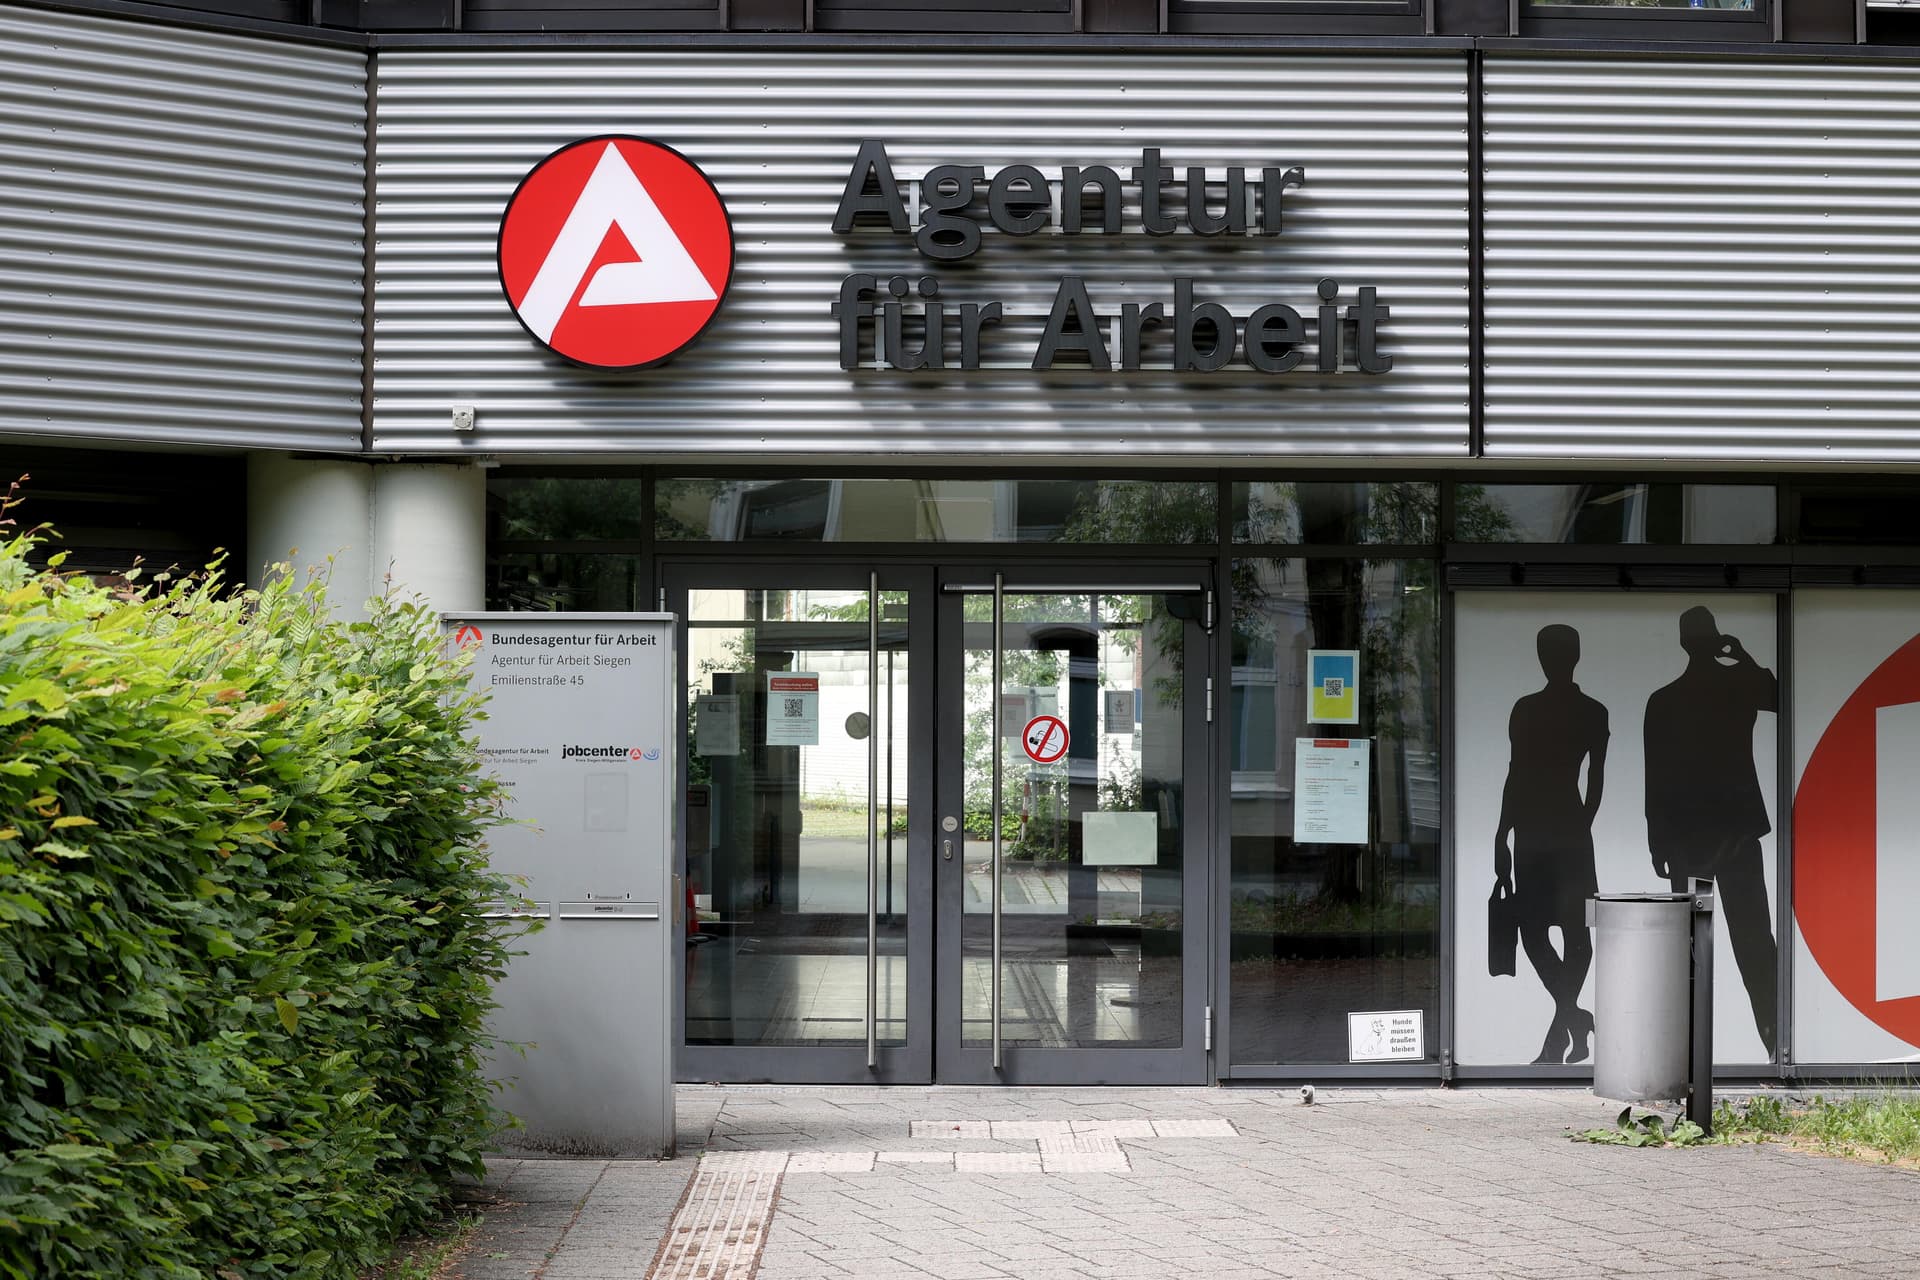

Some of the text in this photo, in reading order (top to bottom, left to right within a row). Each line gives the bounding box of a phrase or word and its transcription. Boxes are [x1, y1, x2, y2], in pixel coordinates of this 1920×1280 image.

[831, 139, 1305, 261] Agentur
[831, 273, 1393, 374] für Arbeit
[491, 633, 657, 648] Bundesagentur für Arbeit
[491, 654, 631, 668] Agentur für Arbeit Siegen
[491, 674, 585, 686] Emilienstraße 45
[562, 744, 630, 760] jobcenter
[1391, 1045, 1416, 1053] bleiben
